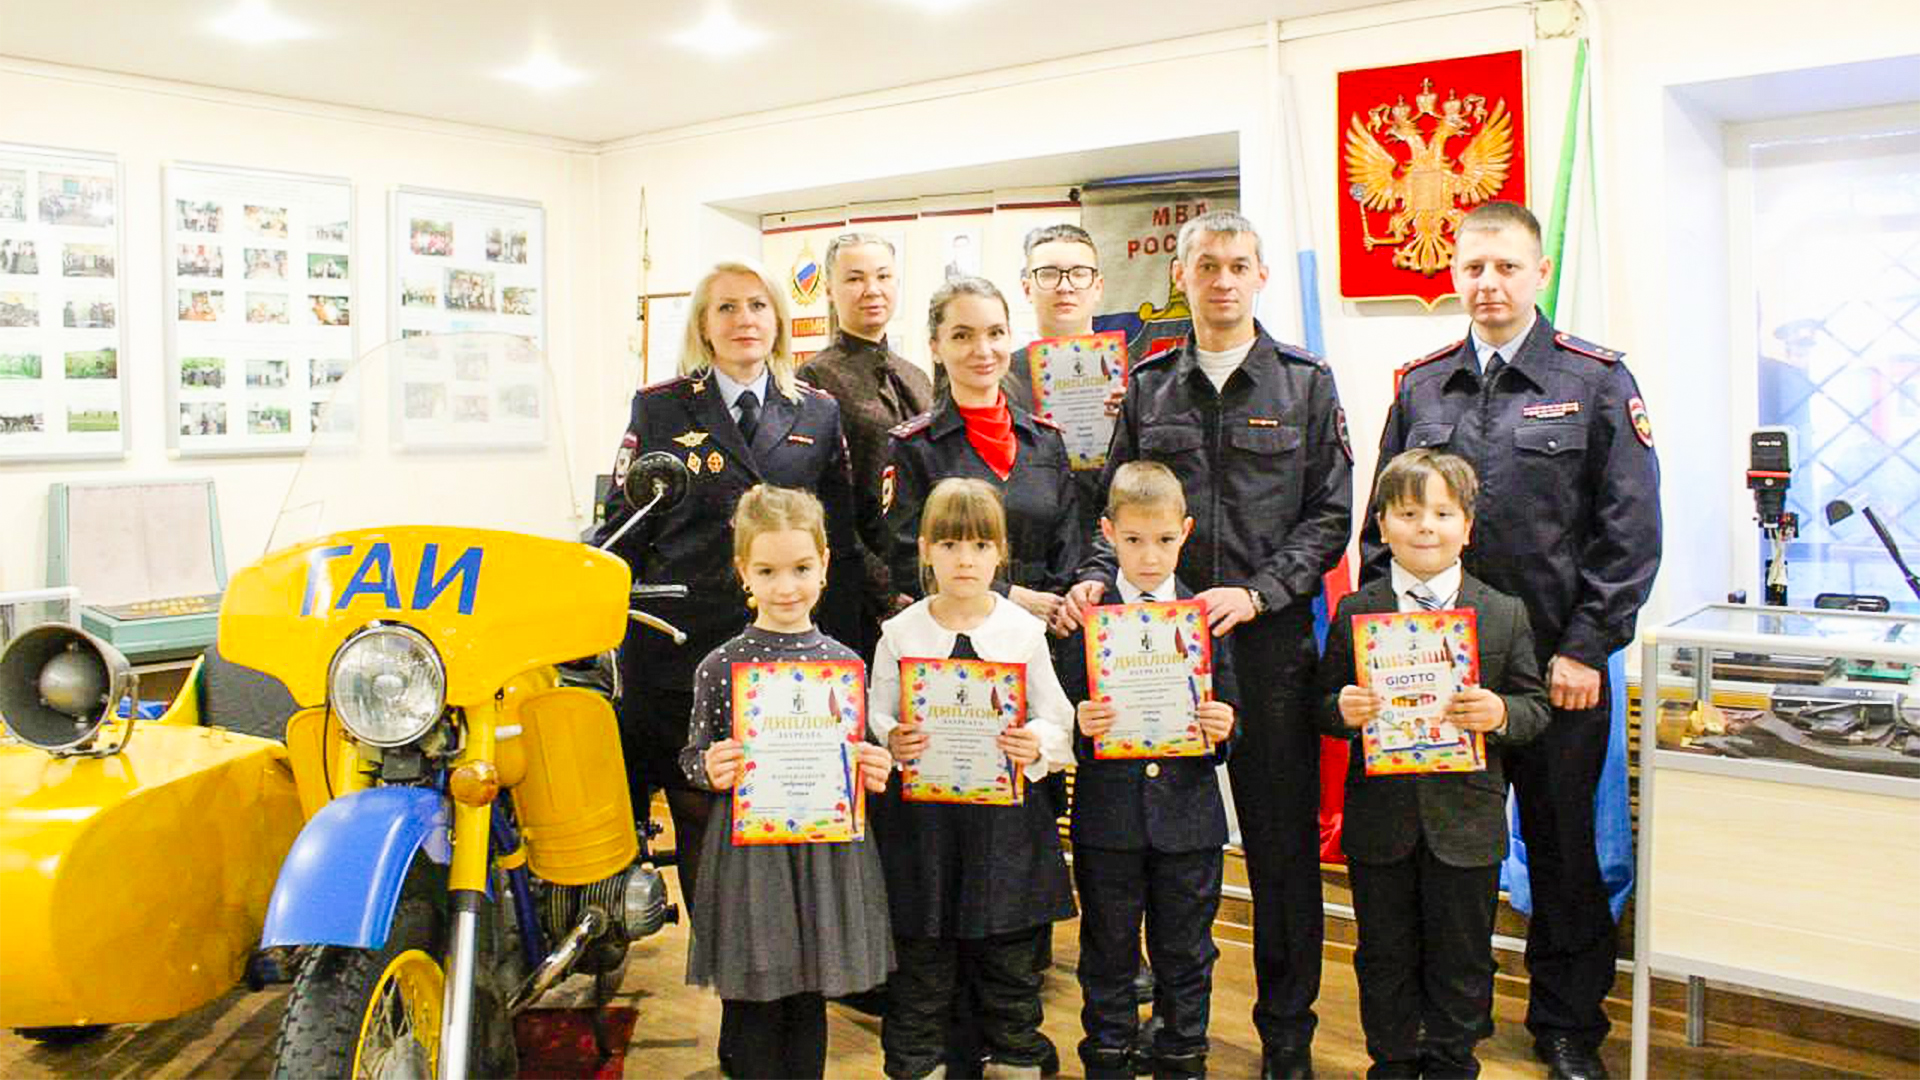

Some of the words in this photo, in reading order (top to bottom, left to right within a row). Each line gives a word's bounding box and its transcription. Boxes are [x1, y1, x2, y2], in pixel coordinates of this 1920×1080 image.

[301, 542, 484, 616] ГАИ
[1385, 672, 1436, 686] GIOTTO
[928, 705, 1000, 720] ДИПЛОМ
[762, 715, 839, 731] ДИПЛОМ
